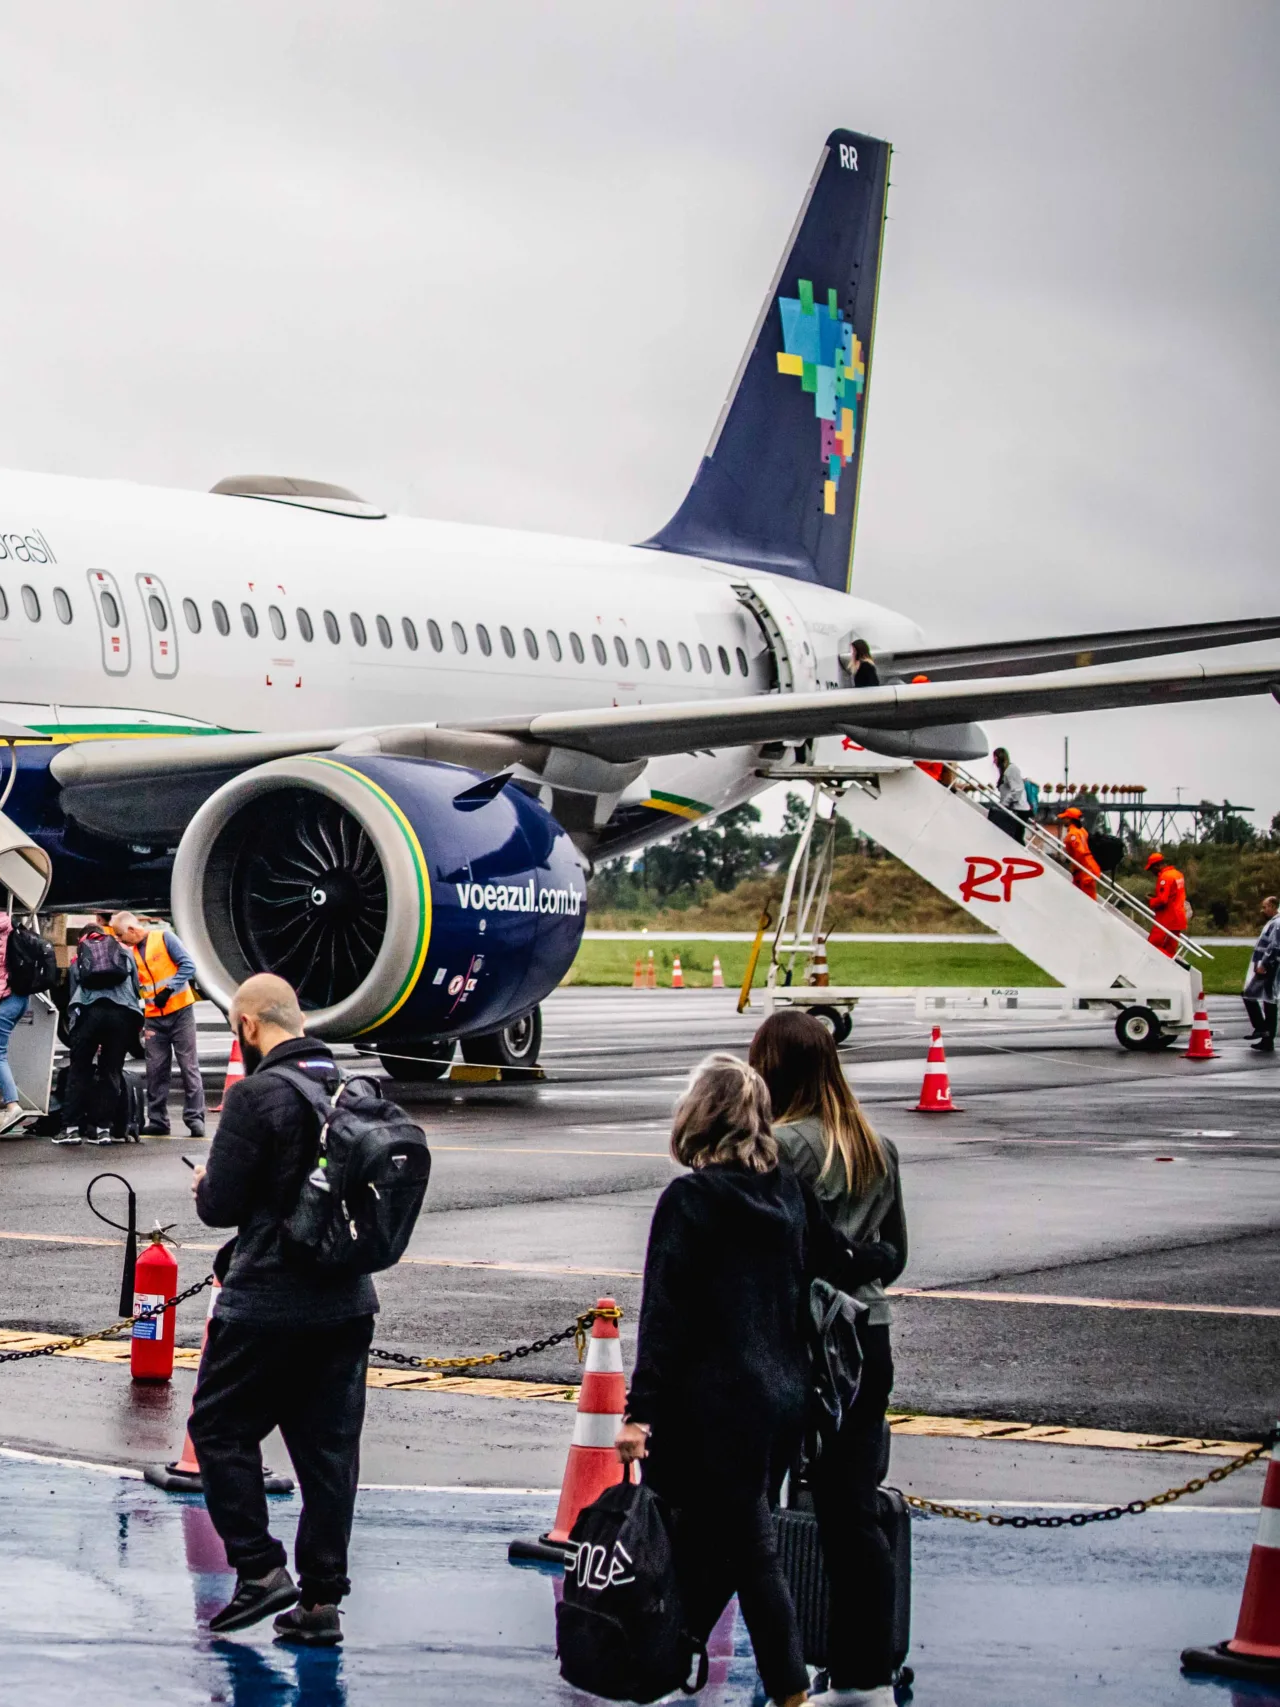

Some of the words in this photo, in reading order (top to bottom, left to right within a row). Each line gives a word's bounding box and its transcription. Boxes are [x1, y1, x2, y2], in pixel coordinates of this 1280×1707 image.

[839, 143, 858, 171] RR
[456, 878, 583, 917] voeazul.com.br
[959, 856, 1044, 902] RP
